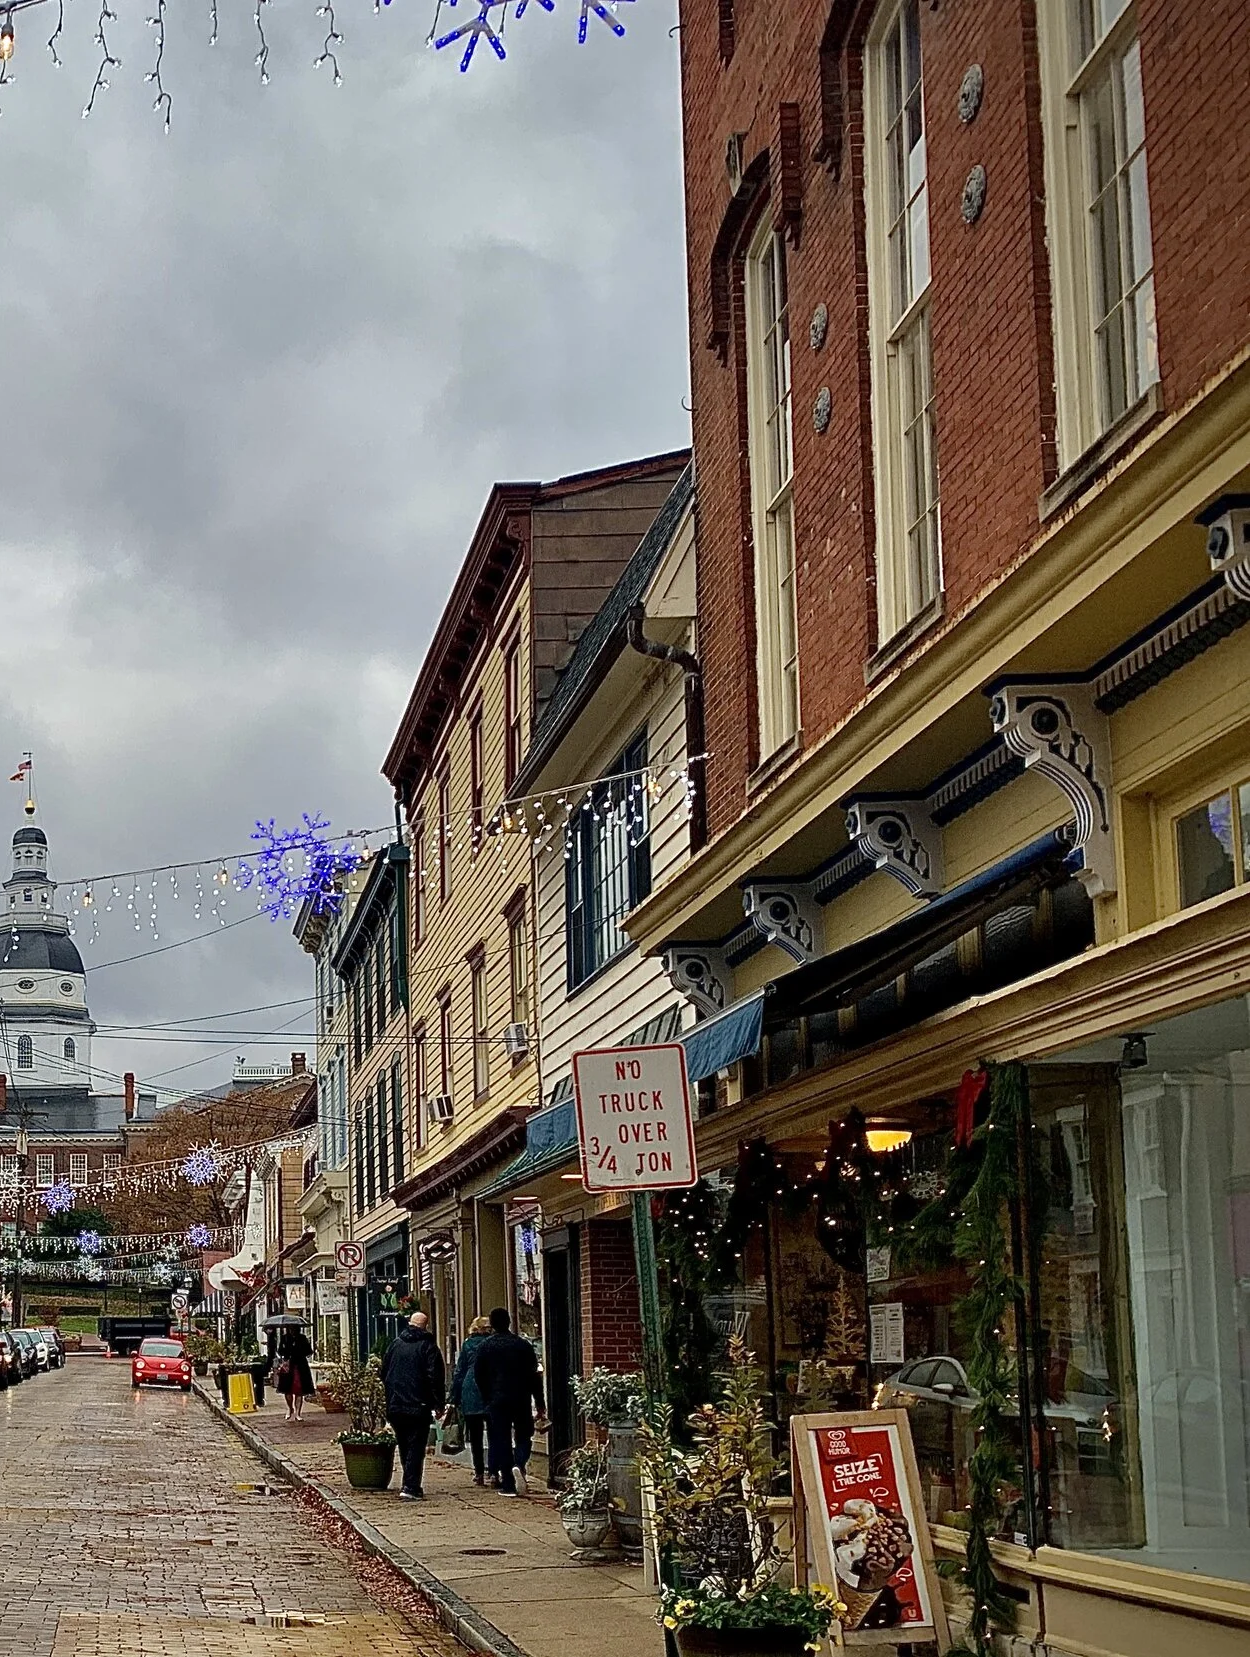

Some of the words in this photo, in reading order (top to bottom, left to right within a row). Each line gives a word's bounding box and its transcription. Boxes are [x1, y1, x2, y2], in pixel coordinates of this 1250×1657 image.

[615, 1059, 641, 1080] NO
[599, 1090, 664, 1114] TRUCK
[618, 1121, 668, 1143] OVER
[289, 1286, 305, 1299] AR
[828, 1447, 850, 1455] HUMOR
[834, 1459, 879, 1478] SEIZE
[837, 1476, 856, 1486] THE
[857, 1472, 882, 1483] CONE
